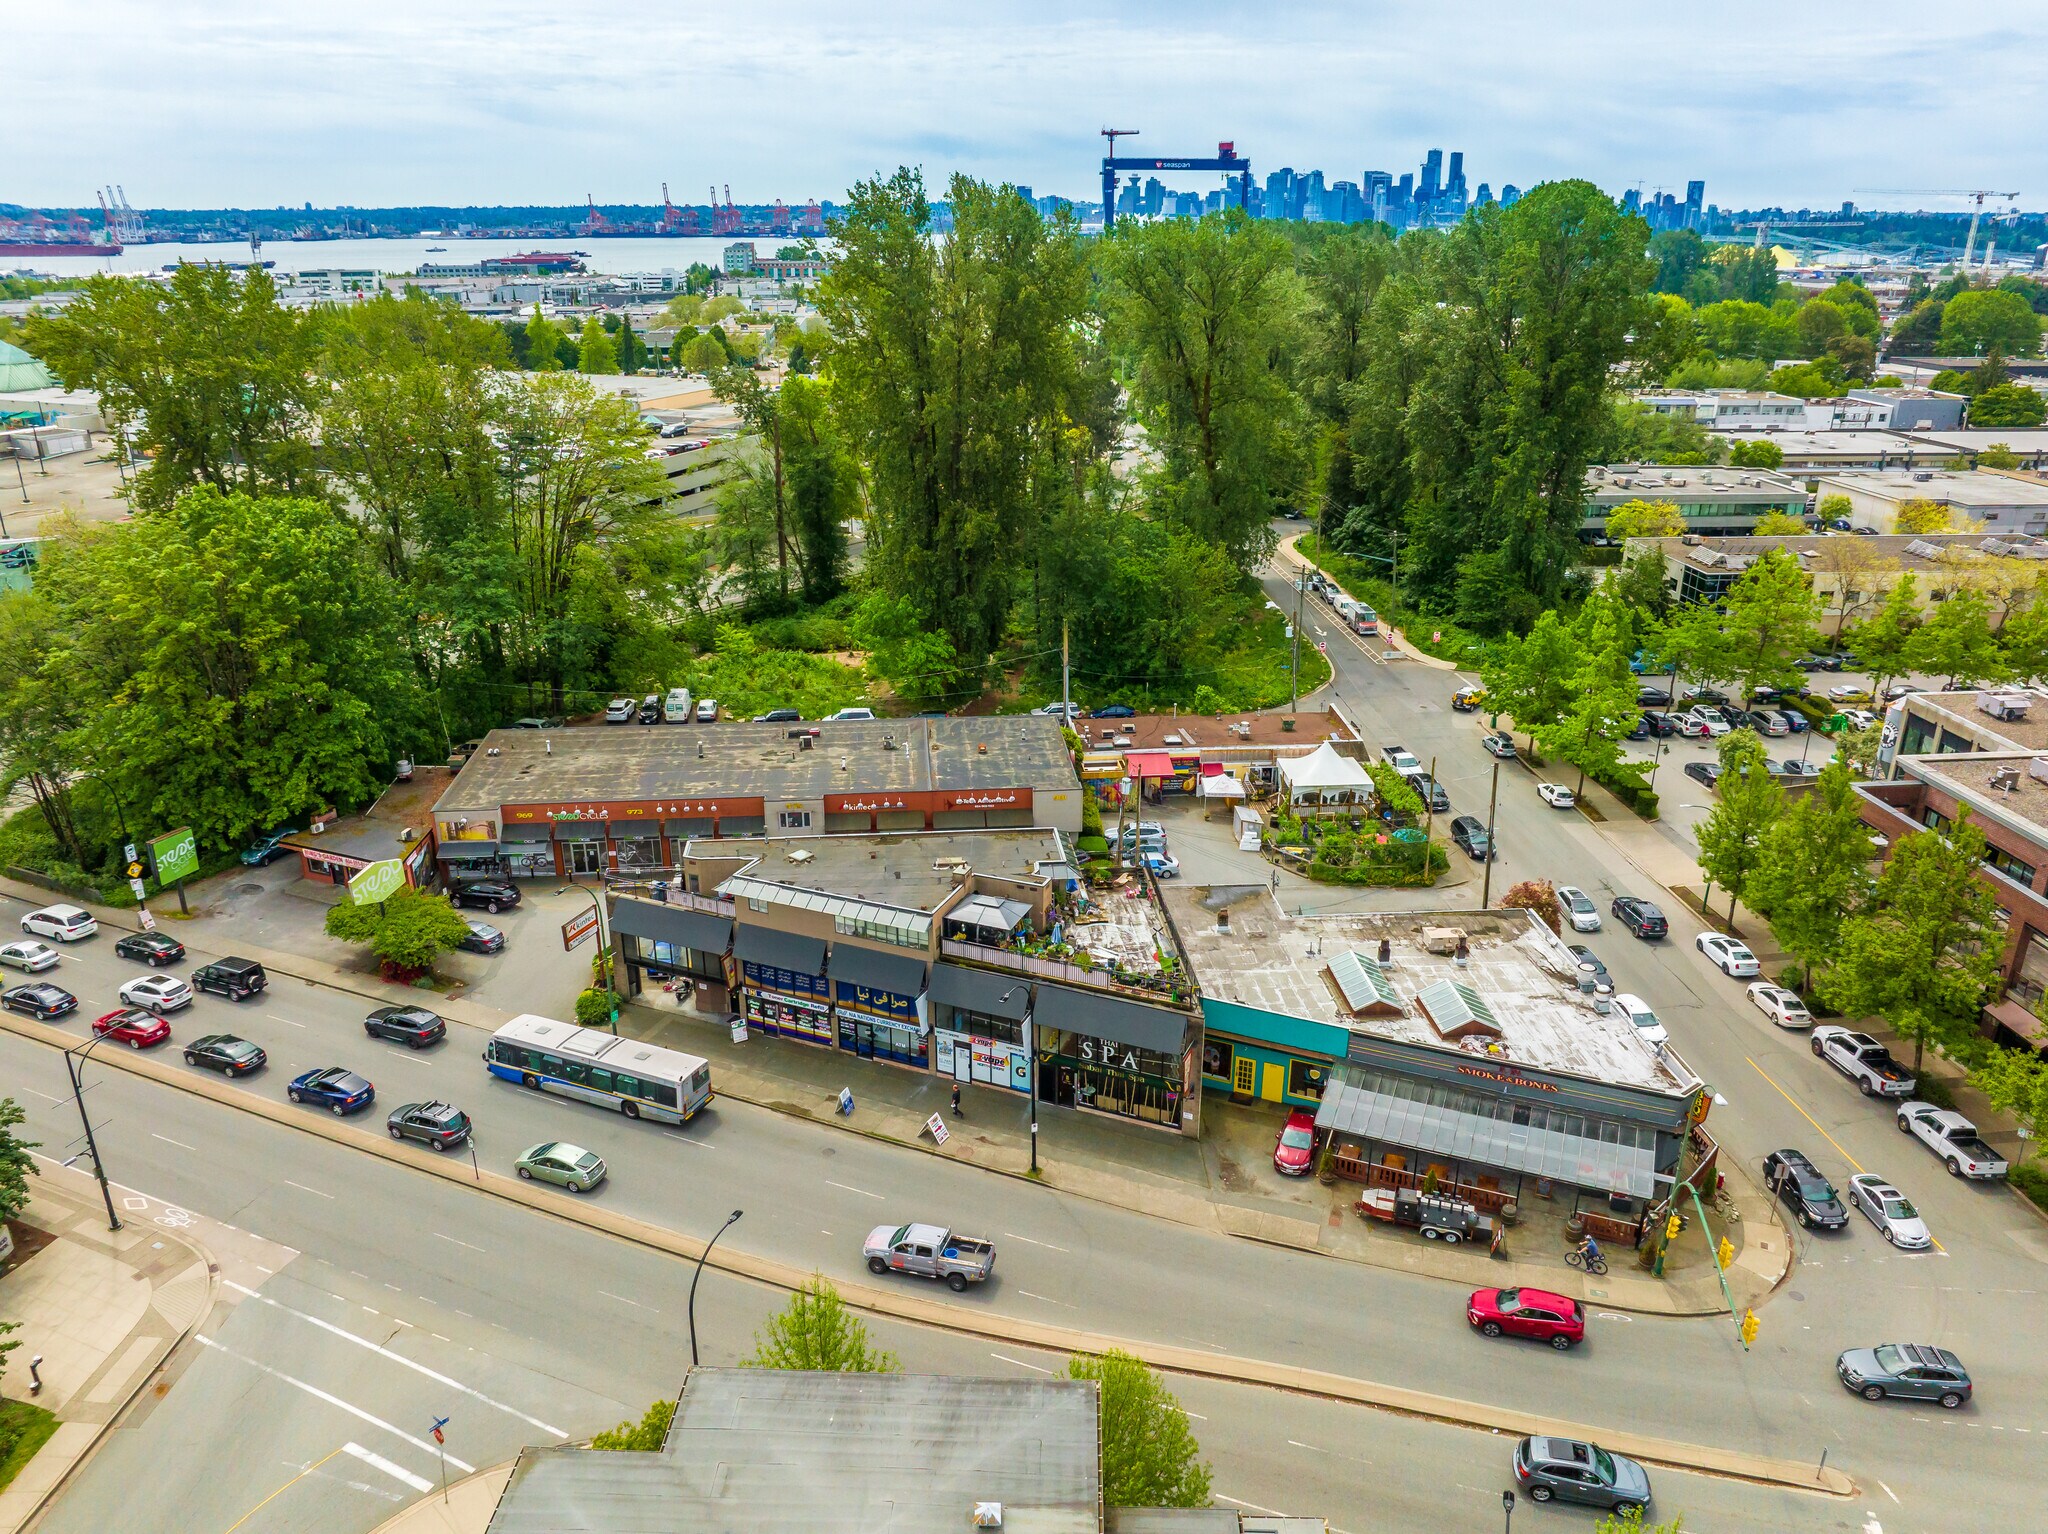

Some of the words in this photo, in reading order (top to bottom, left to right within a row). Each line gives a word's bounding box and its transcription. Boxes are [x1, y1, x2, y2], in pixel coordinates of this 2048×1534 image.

[579, 812, 608, 820] CYCLES
[575, 913, 594, 930] kintec
[783, 997, 810, 1008] Cartridge
[857, 1013, 876, 1023] NATIONS
[876, 1018, 901, 1029] CURRENCY
[1100, 1038, 1118, 1048] THAI
[1081, 1041, 1139, 1071] SPA
[1015, 1066, 1027, 1078] G
[1078, 1061, 1102, 1073] Sabai
[1105, 1068, 1125, 1078] Thai
[1128, 1073, 1145, 1083] Spa
[1458, 1066, 1505, 1082] SMOKE
[1515, 1078, 1558, 1092] BONES
[1693, 1090, 1704, 1117] BBQ
